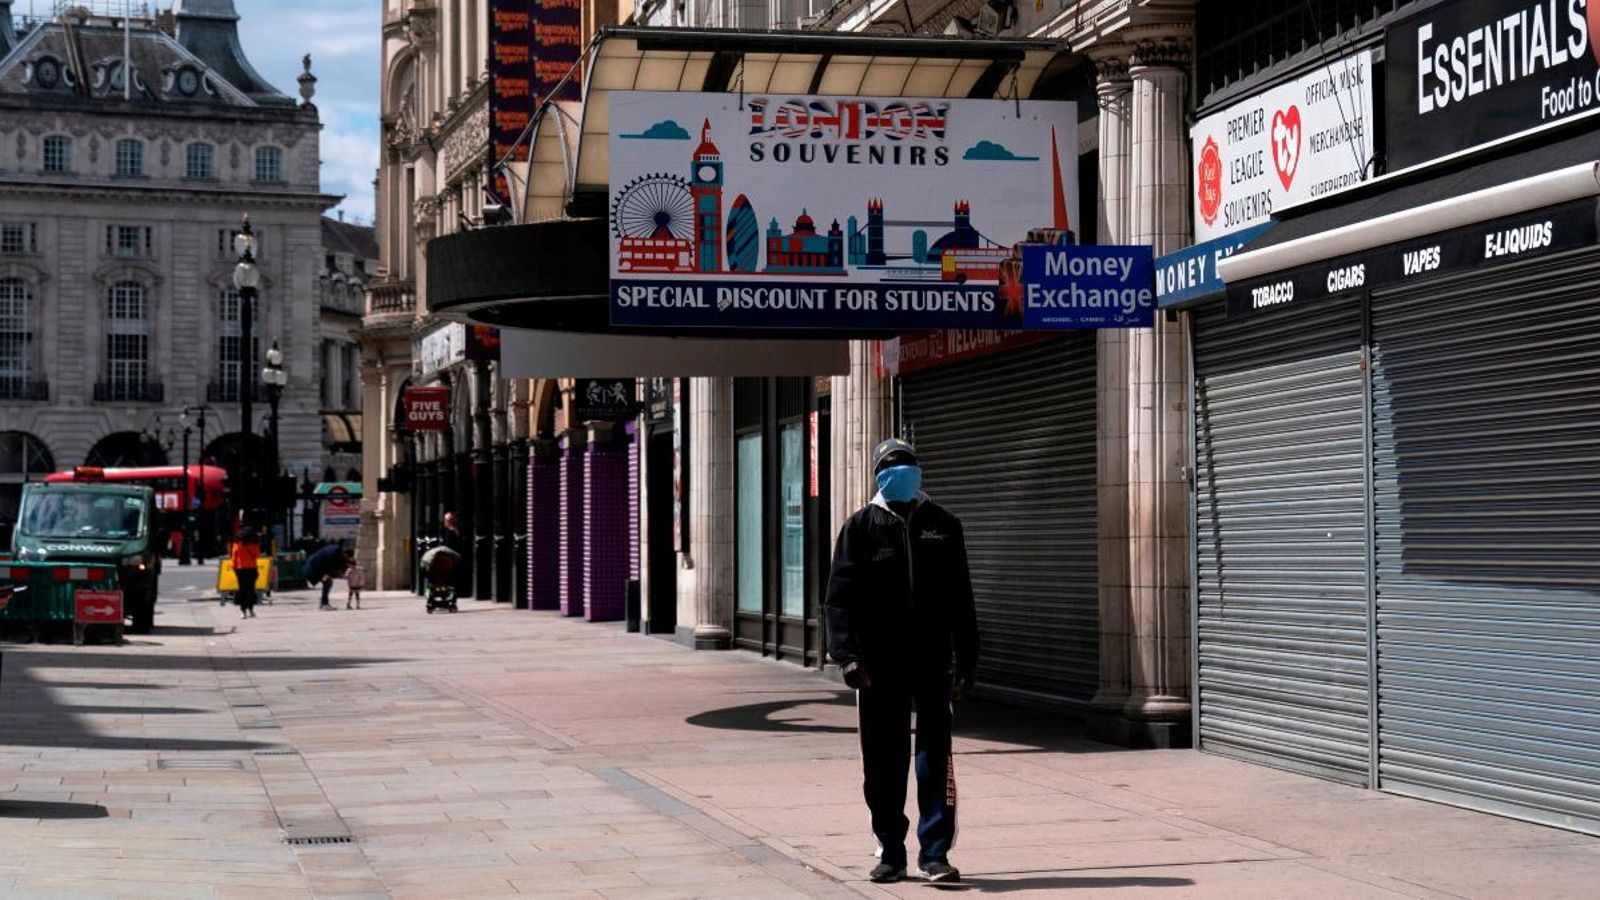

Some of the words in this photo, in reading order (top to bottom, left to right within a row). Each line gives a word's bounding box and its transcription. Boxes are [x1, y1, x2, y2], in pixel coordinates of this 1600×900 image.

[1418, 0, 1588, 115] ESSENTIALS
[1305, 76, 1338, 106] OFFICIAL
[1541, 77, 1575, 119] Food
[1578, 75, 1592, 107] to
[748, 97, 949, 141] LONDON
[1227, 107, 1265, 145] PREMIER
[1309, 117, 1363, 155] MERCHANDISE
[750, 141, 949, 166] SOUVENIRS
[1230, 150, 1264, 184] LEAGUE
[1224, 189, 1272, 228] SOUVENIRS
[1045, 251, 1134, 282] Money
[1156, 254, 1207, 297] MONEY
[1252, 280, 1294, 308] TOBACCO
[1327, 263, 1366, 293] CIGARS
[1403, 246, 1441, 275] VAPES
[1484, 221, 1553, 258] E-LIQUIDS
[617, 286, 710, 307] SPECIAL
[716, 288, 828, 311] DISCOUNT
[834, 289, 878, 310] FOR
[885, 290, 995, 312] STUDENTS
[1027, 282, 1152, 314] Exchange
[409, 411, 445, 421] GUYS
[412, 401, 441, 411] FIVE
[46, 543, 115, 553] CONWAY
